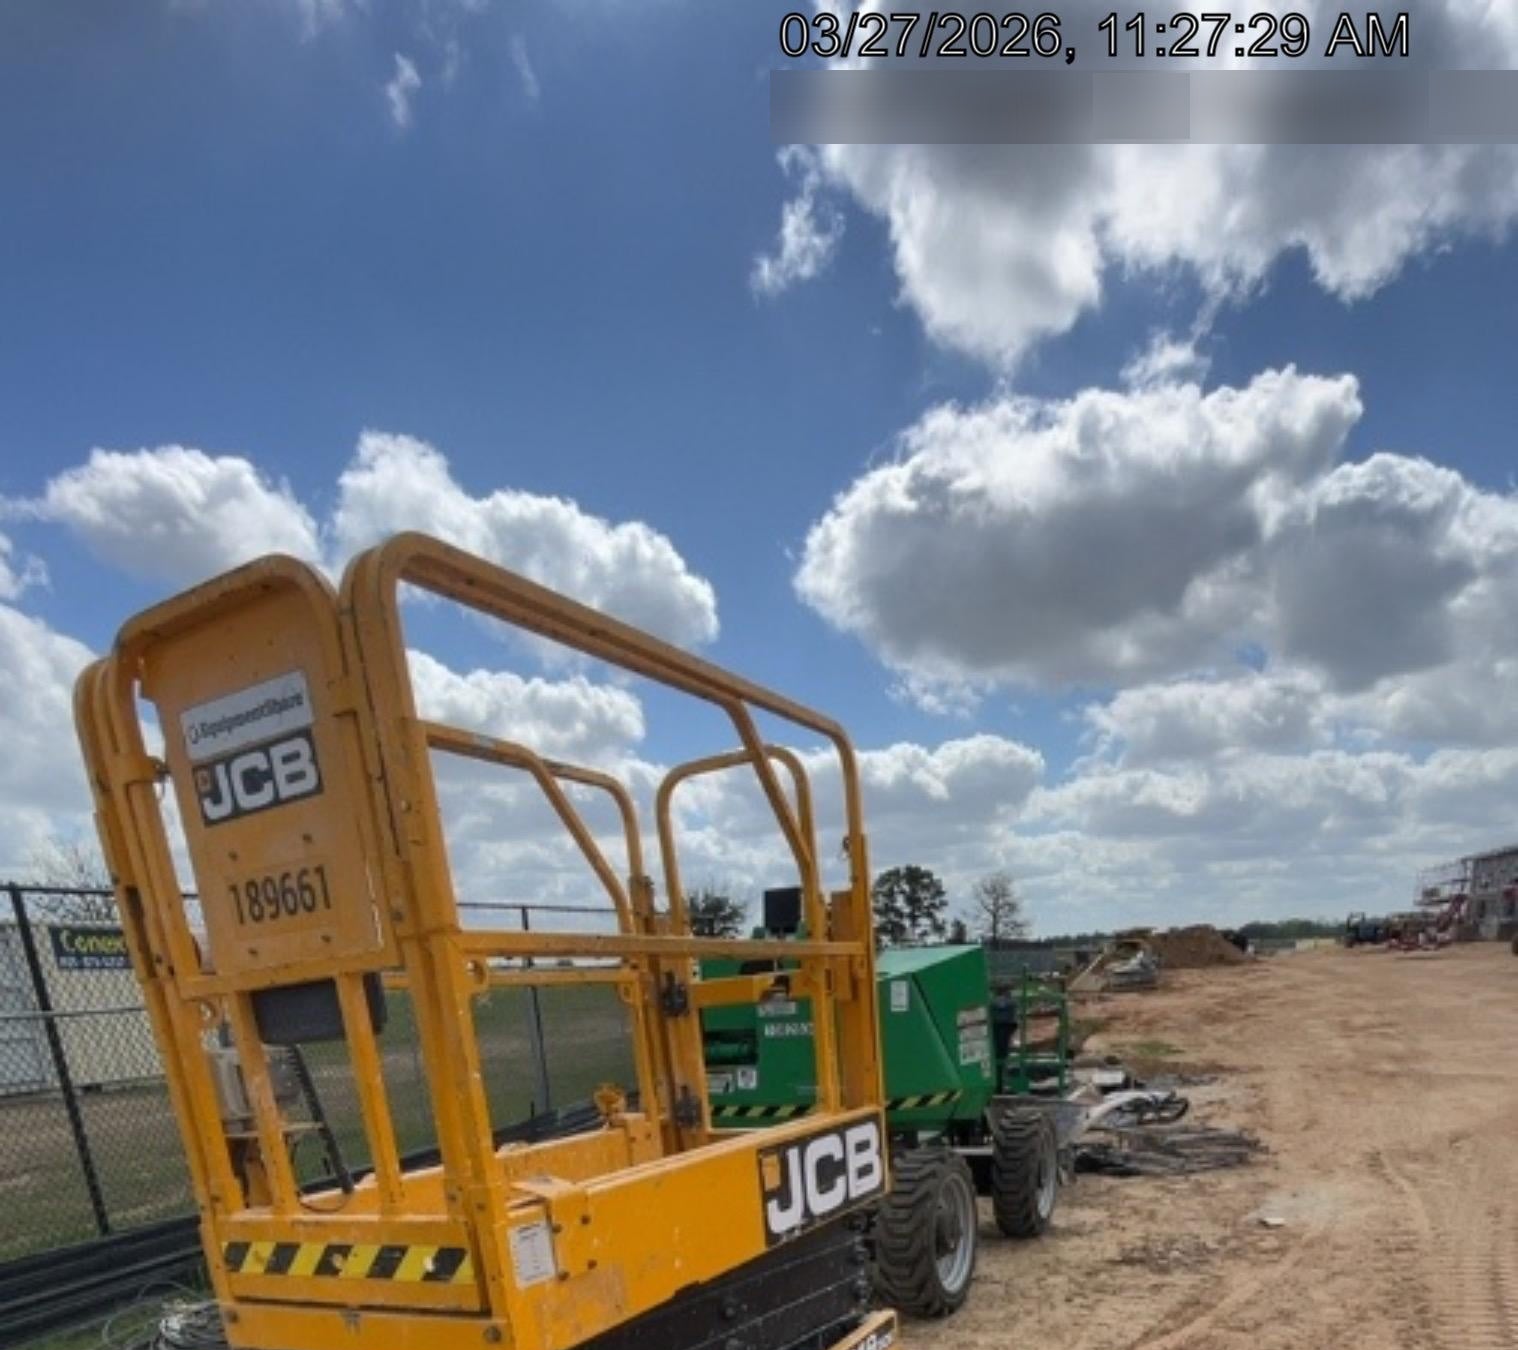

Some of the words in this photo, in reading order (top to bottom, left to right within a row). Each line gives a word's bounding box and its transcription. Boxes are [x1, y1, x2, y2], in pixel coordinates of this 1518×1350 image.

[203, 737, 319, 820] JCB
[228, 865, 331, 925] 189661
[767, 1122, 882, 1234] JCB
